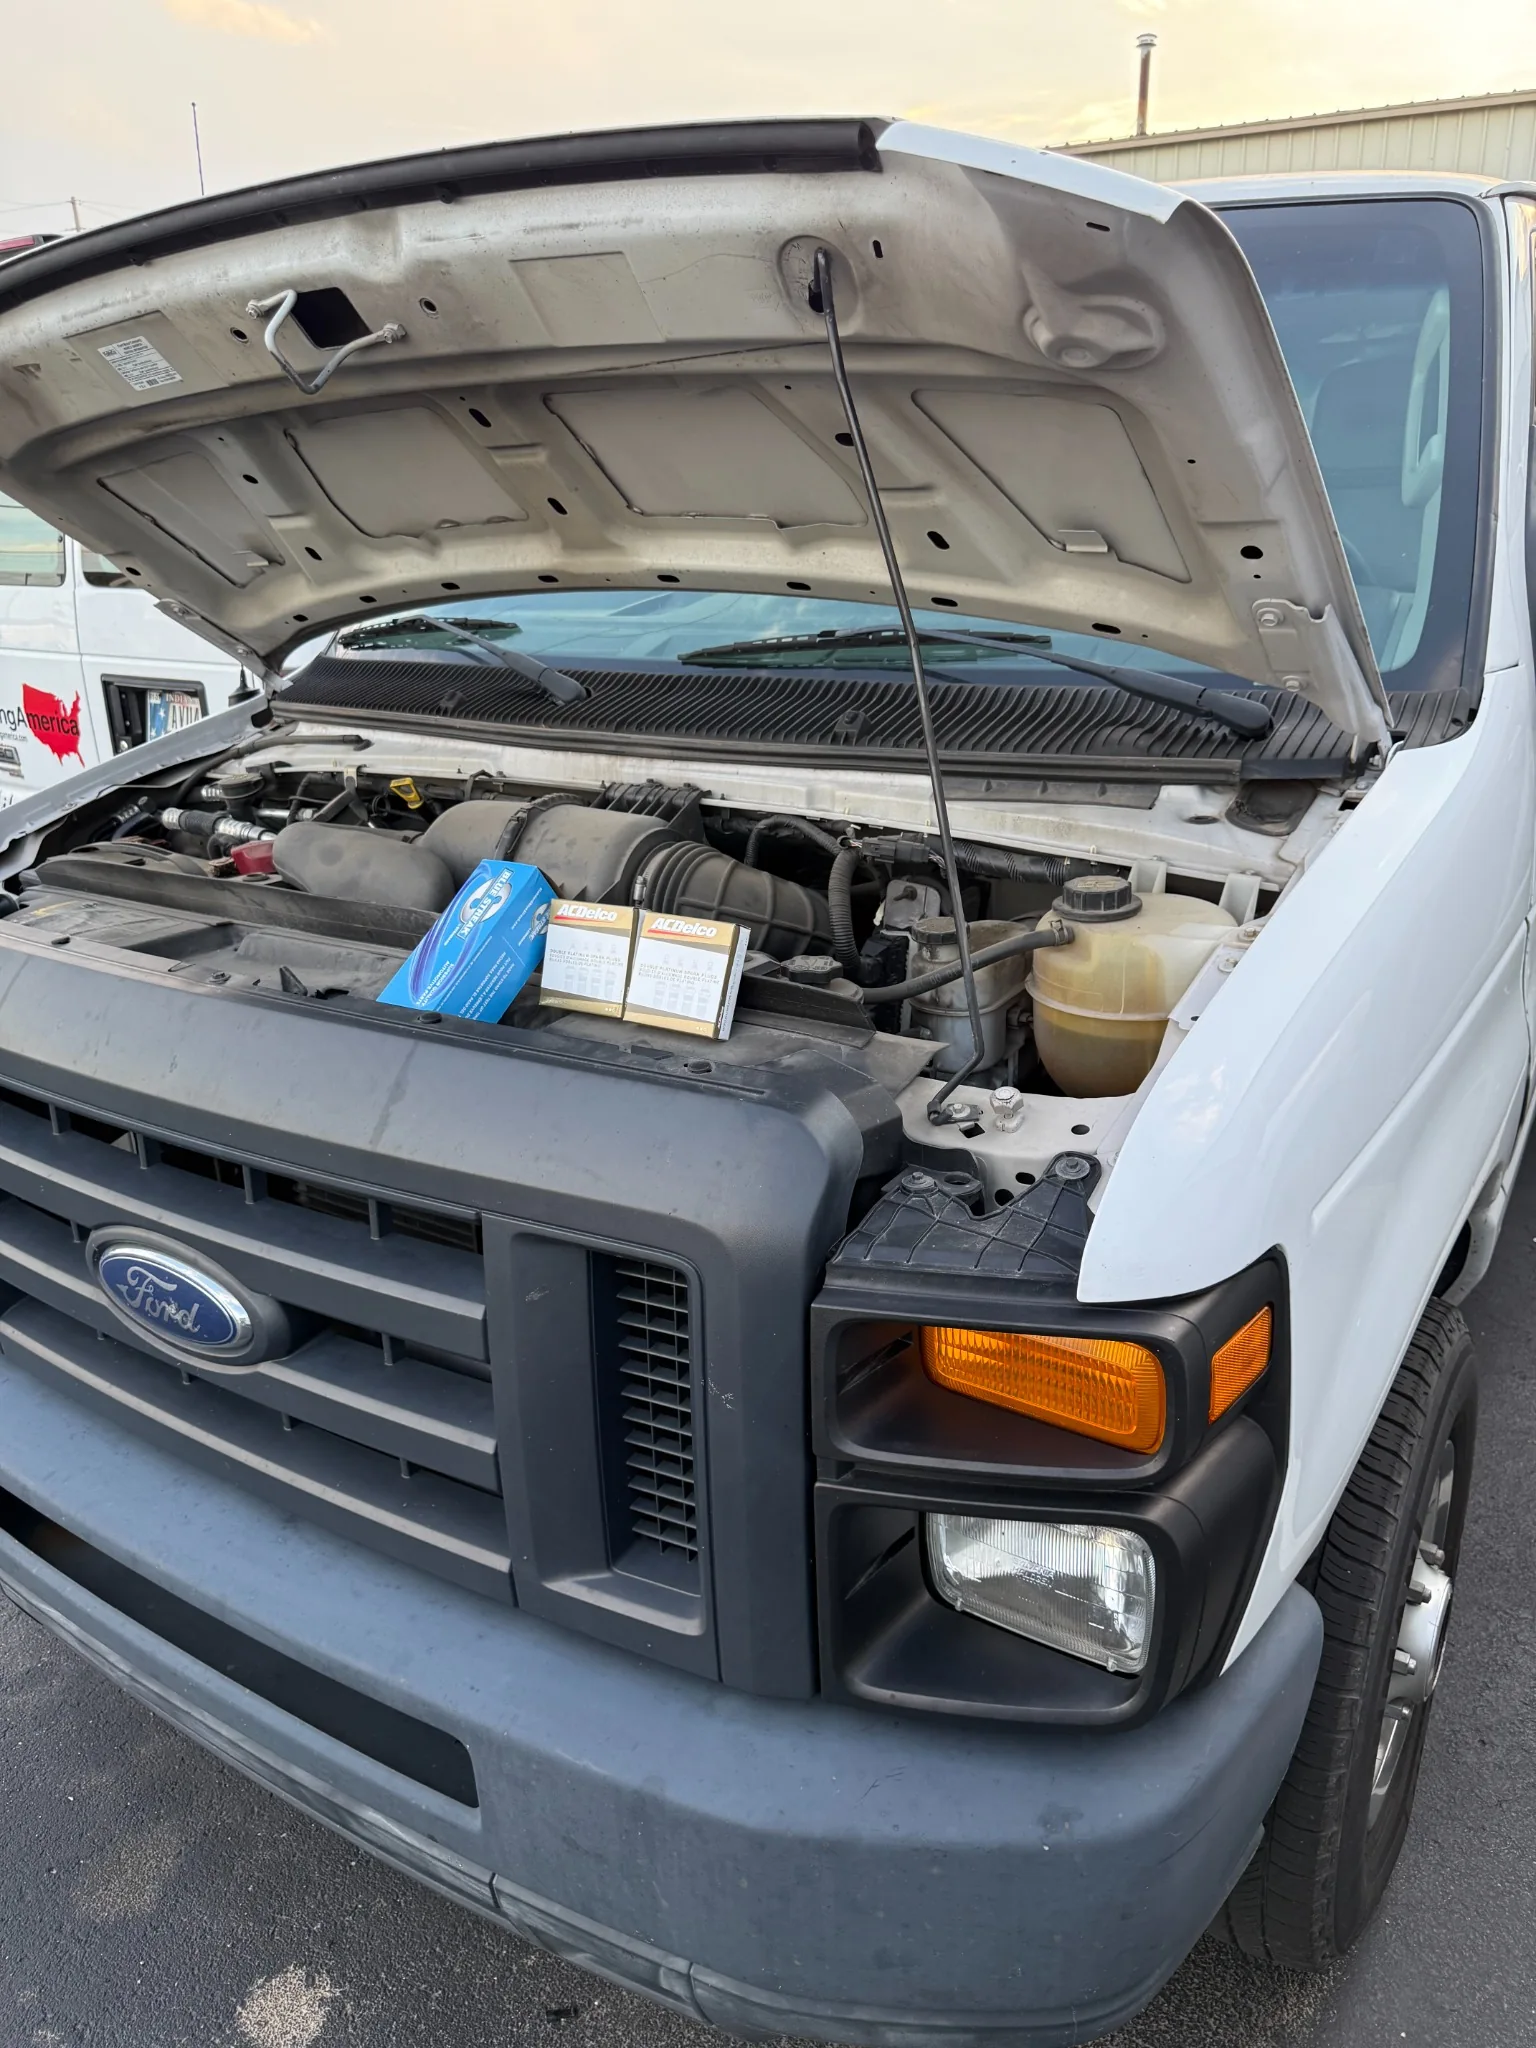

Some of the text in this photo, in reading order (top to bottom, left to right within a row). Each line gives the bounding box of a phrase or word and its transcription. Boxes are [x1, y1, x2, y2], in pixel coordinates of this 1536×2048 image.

[488, 871, 511, 896] BLUE
[459, 896, 493, 936] STREAK
[557, 903, 617, 921] ACDelco
[650, 917, 718, 938] ACDelco
[415, 960, 450, 1005] AUTOMOTIVE PARTS
[420, 963, 454, 1006] SUPERIOR QUALITY
[116, 1265, 201, 1334] Ford
